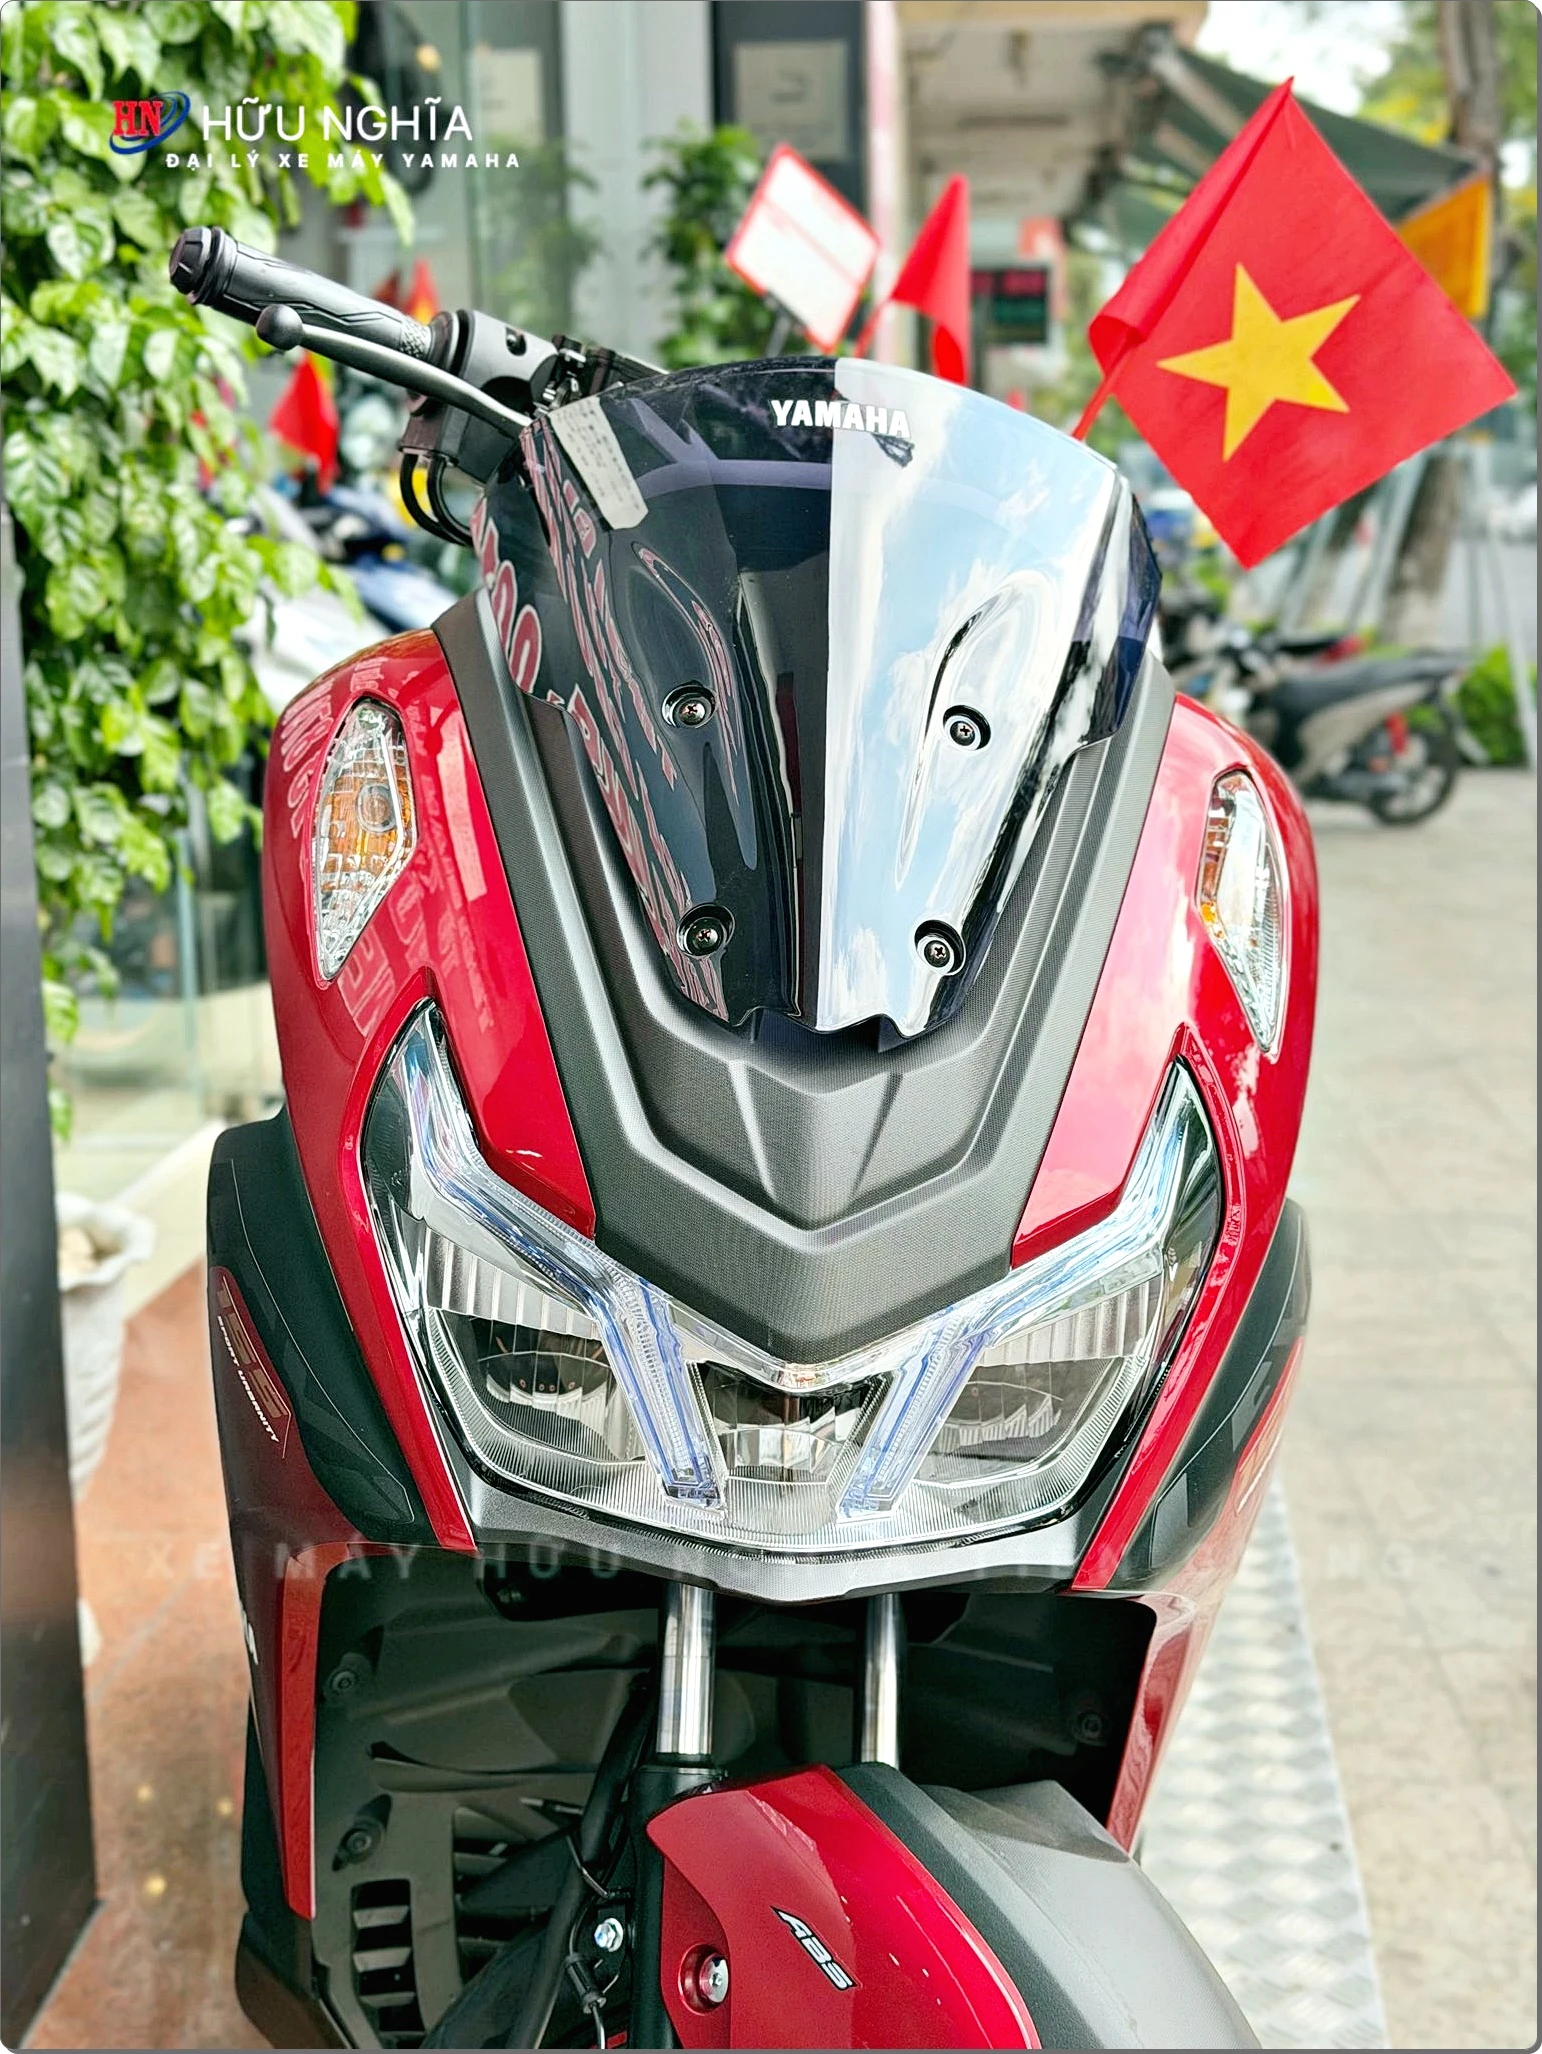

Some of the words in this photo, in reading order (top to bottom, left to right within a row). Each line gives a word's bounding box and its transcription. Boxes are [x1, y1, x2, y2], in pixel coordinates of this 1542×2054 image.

[770, 400, 912, 439] YAMAHA
[238, 1370, 280, 1443] URBANITY
[771, 1906, 857, 1990] ABS
